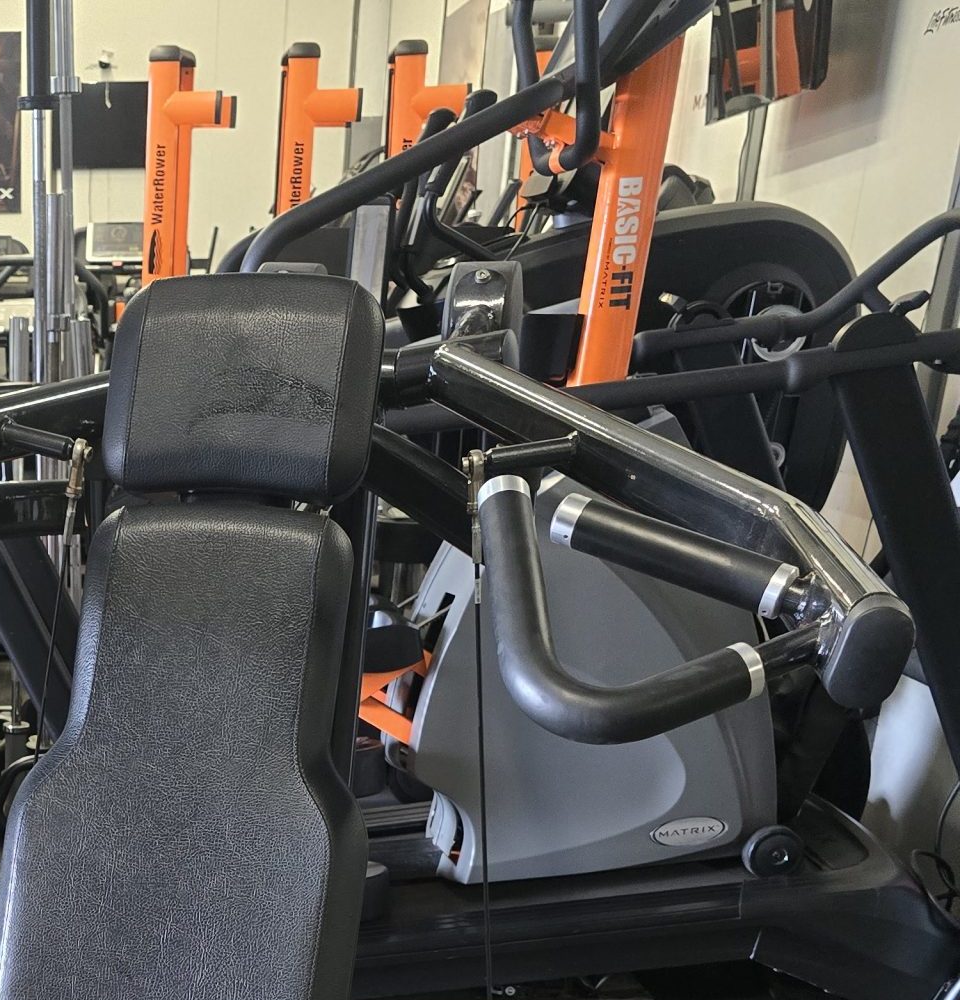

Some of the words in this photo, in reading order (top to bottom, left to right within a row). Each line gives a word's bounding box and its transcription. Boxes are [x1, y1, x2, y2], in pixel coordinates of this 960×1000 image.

[151, 144, 166, 225] WaterRower
[290, 142, 304, 208] terRower
[608, 176, 644, 310] BASIC-FIT
[598, 262, 611, 308] MATRIX
[659, 825, 716, 838] MATRIX
